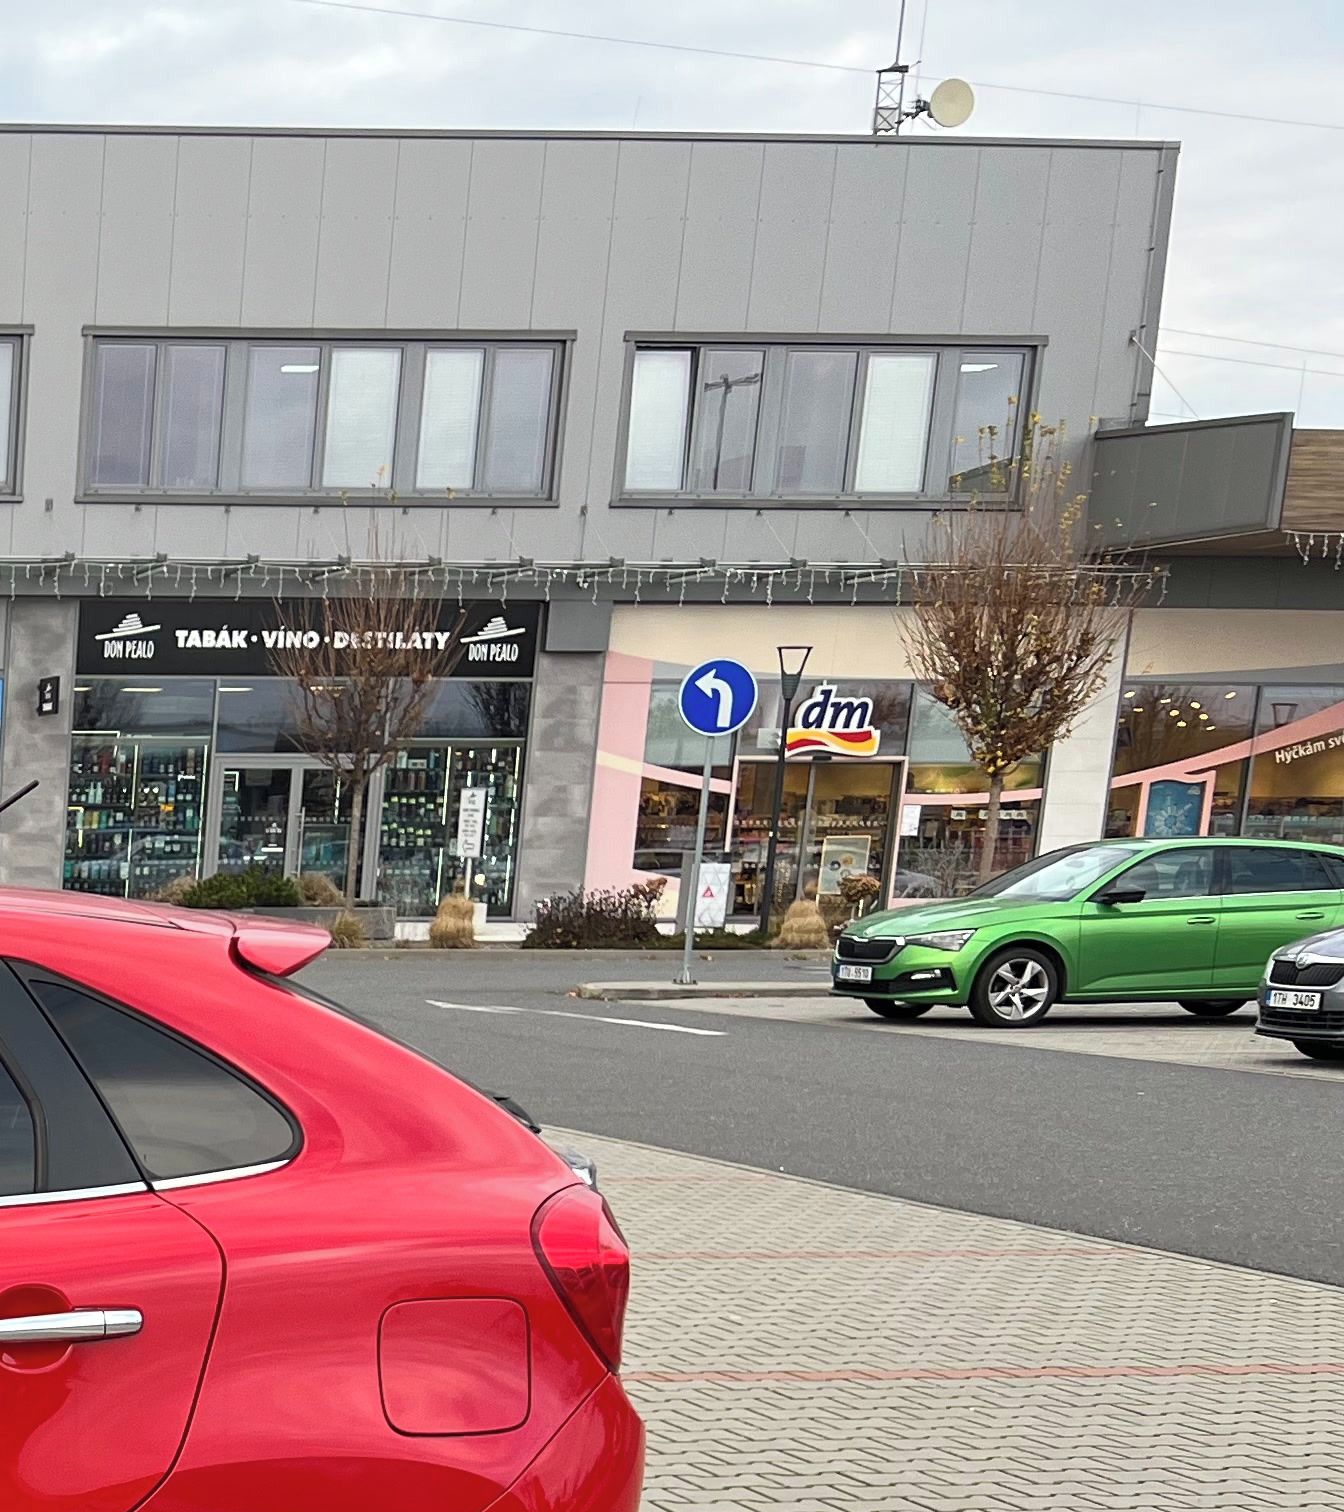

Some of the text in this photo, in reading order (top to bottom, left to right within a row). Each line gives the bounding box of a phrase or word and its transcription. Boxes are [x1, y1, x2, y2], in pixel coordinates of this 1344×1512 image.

[175, 624, 248, 648] TABÁK
[262, 625, 320, 649] VÍNO
[103, 641, 154, 658] DON PEALO
[468, 643, 519, 661] DON PEALO
[801, 689, 870, 729] dm
[1275, 733, 1344, 764] Hýčkám sv
[1293, 993, 1316, 1007] 3405
